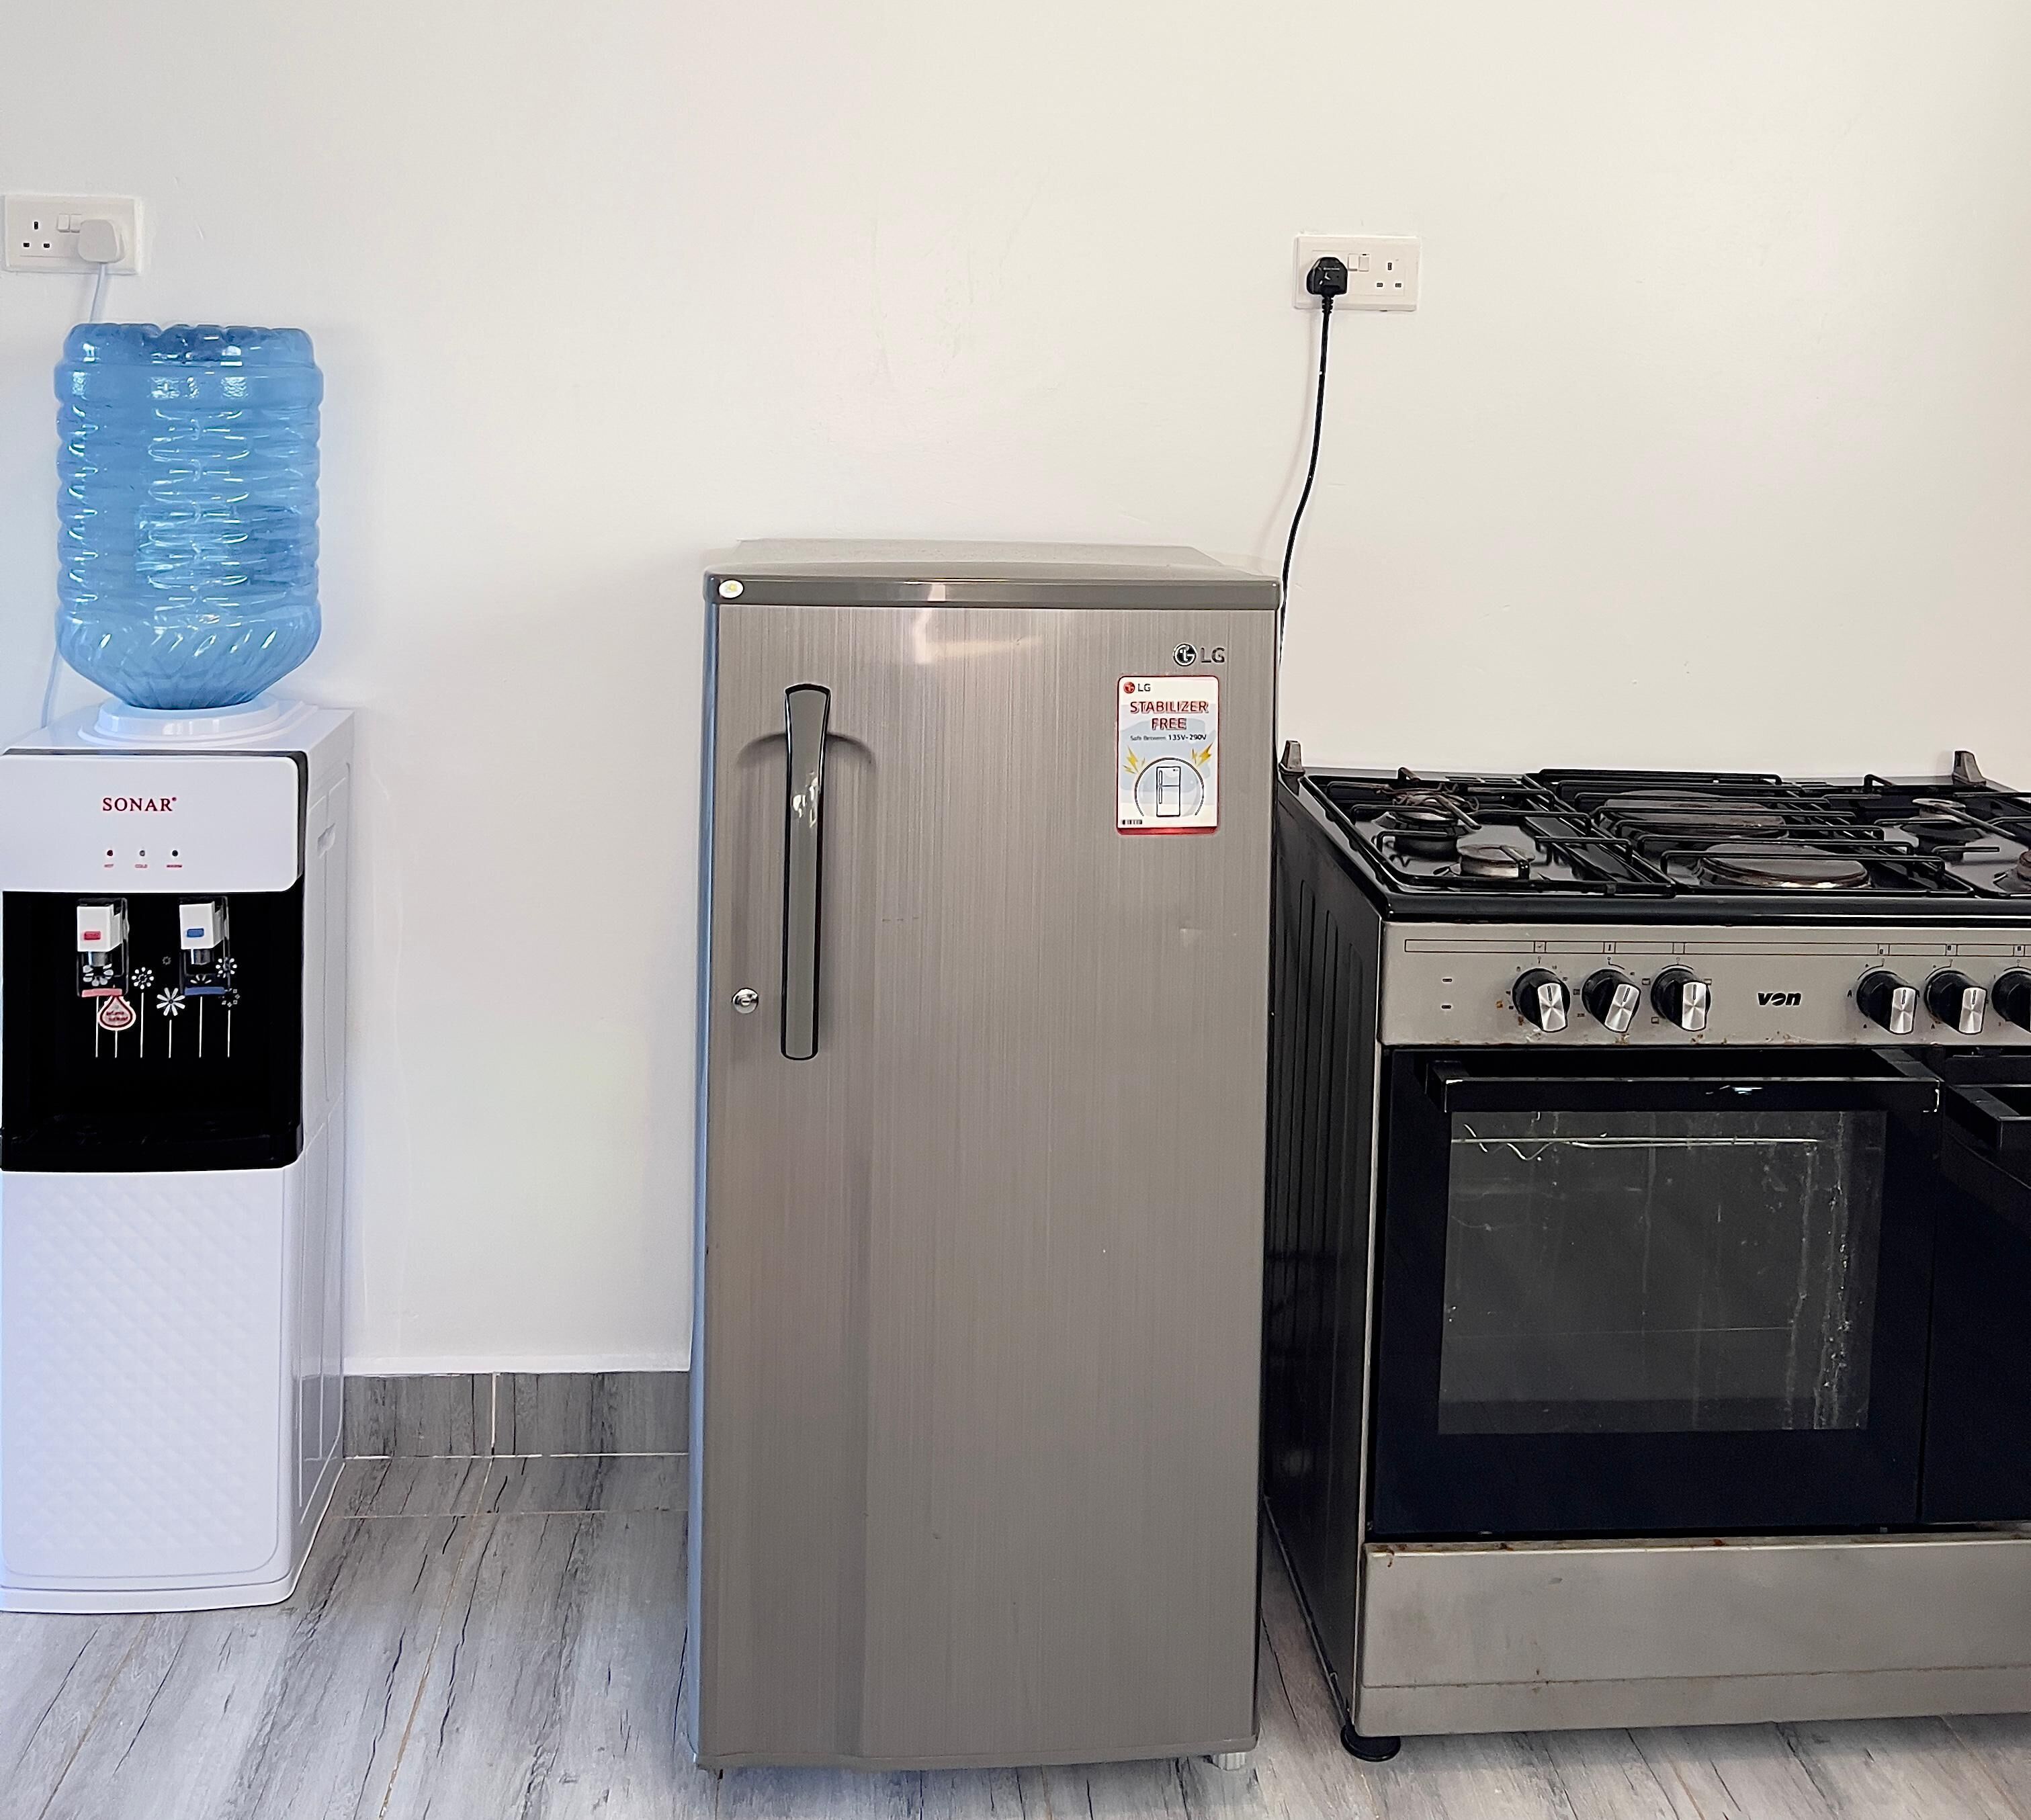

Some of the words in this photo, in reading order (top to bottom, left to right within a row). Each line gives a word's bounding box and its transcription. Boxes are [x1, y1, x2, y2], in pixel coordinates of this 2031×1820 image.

[1201, 647, 1225, 663] LG
[1137, 683, 1151, 692] LG
[1130, 701, 1209, 713] STABILIZER
[1152, 718, 1187, 730] FREE
[102, 797, 173, 812] SONAR
